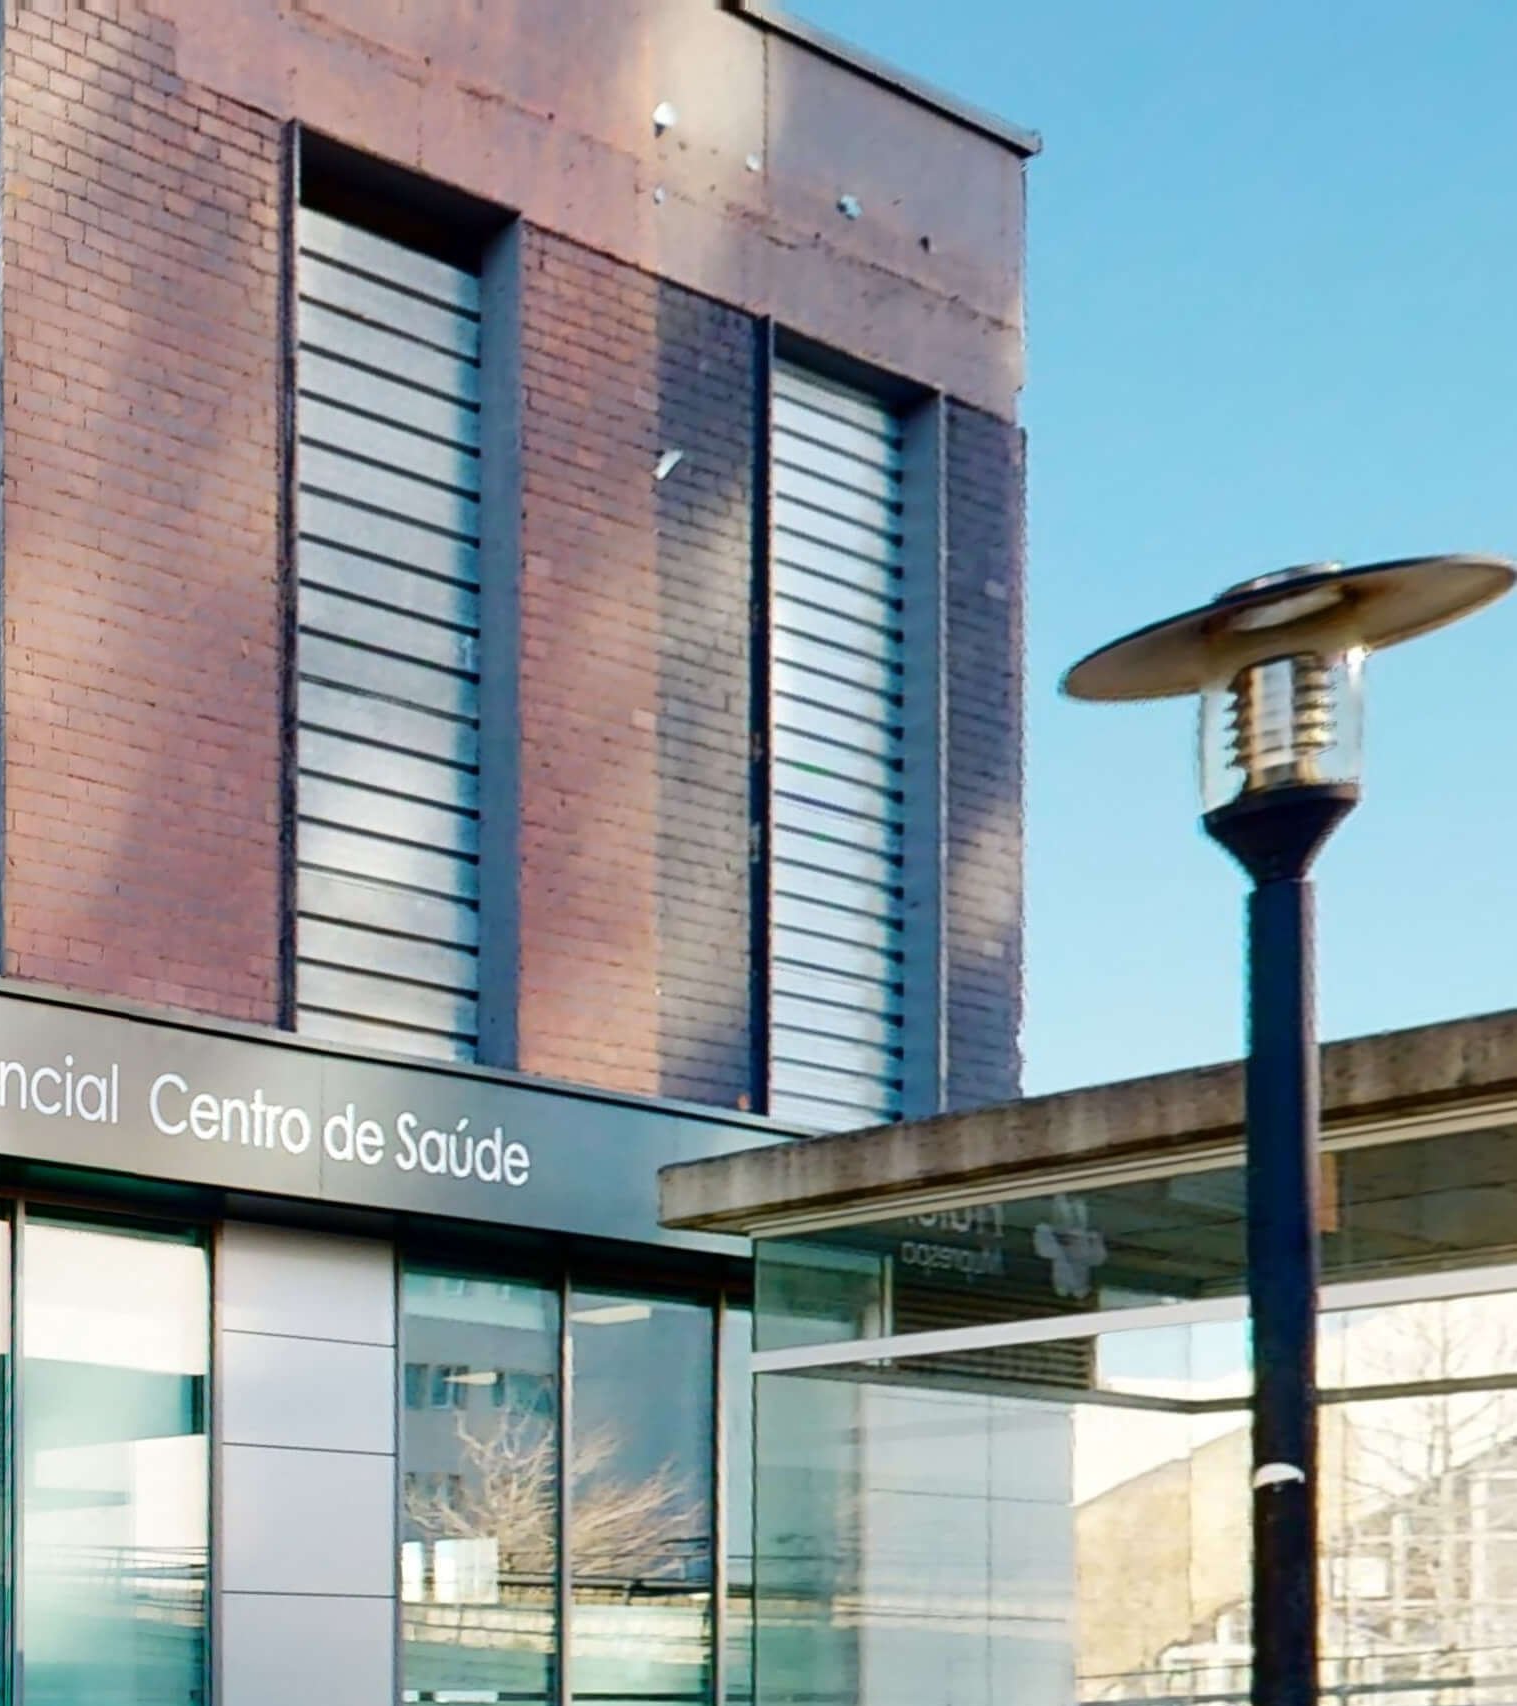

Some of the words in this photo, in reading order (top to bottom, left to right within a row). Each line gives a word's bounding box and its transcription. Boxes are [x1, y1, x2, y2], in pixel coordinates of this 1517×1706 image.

[148, 1071, 314, 1156] Centro
[322, 1102, 386, 1166] de
[394, 1111, 530, 1187] Saúde
